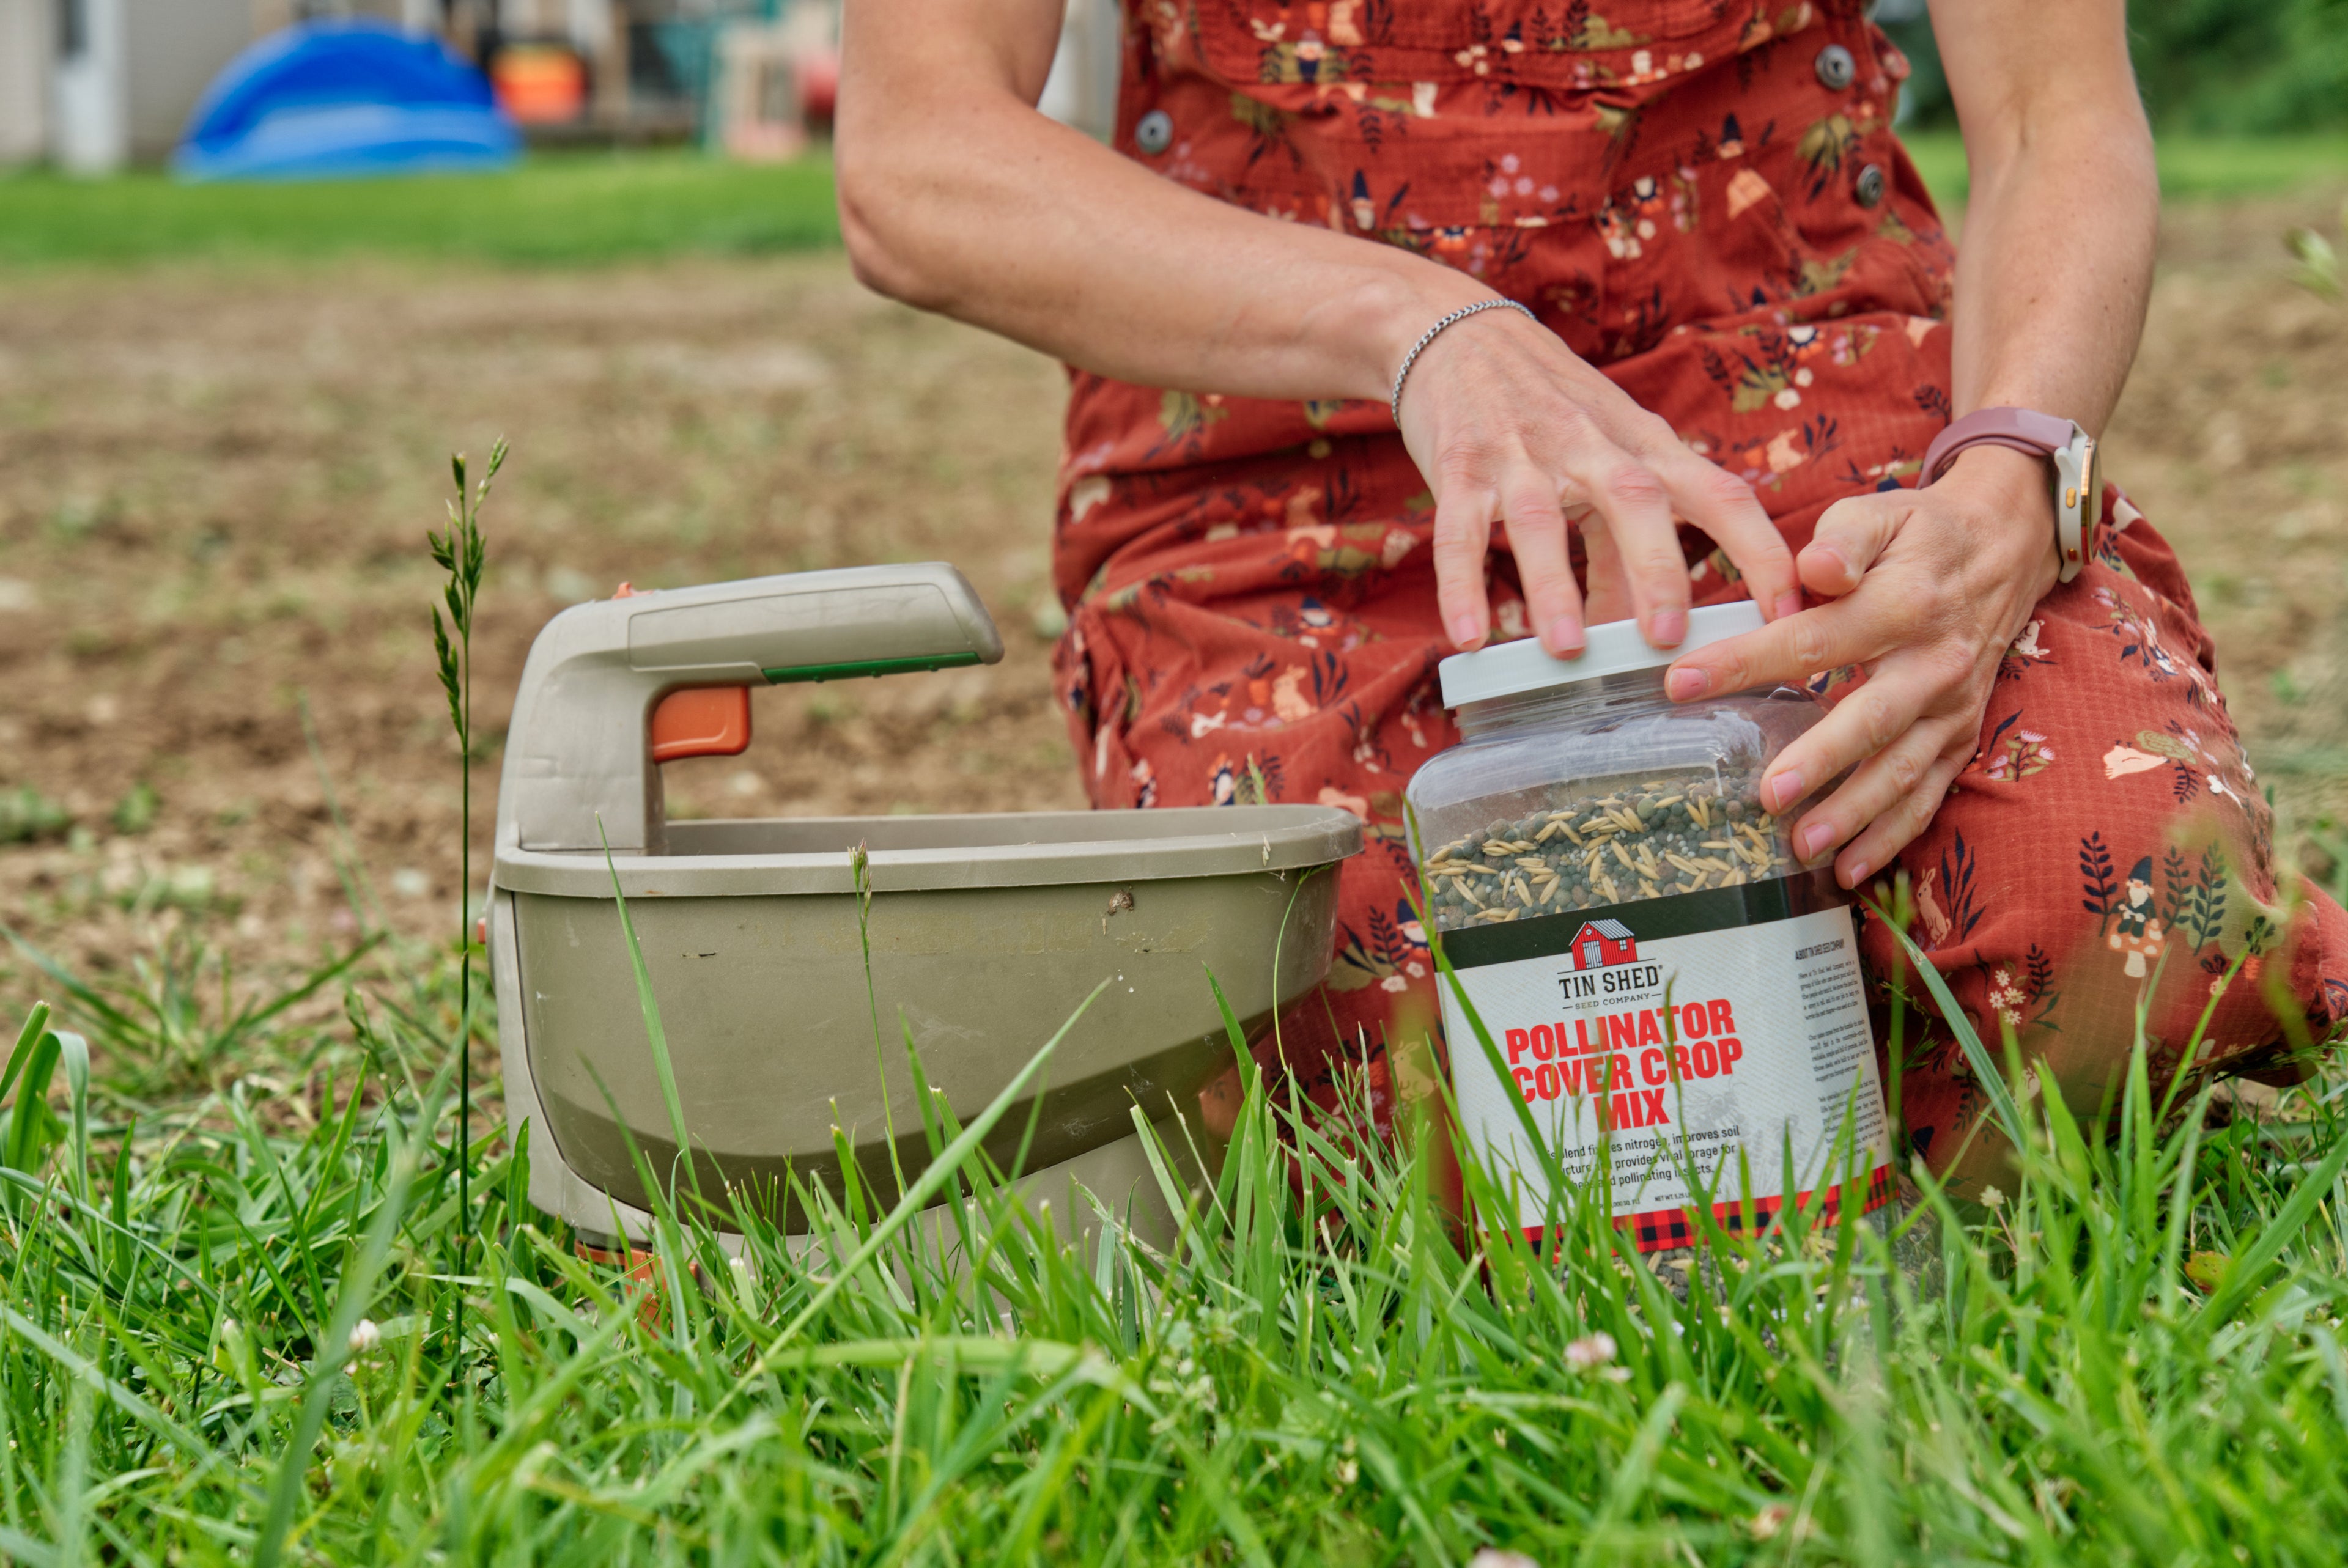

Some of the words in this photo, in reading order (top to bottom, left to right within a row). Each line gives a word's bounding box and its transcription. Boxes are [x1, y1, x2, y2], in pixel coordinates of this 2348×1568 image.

[1795, 948, 1808, 960] ABOUT
[1559, 974, 1595, 999] TIN
[1575, 1001, 1600, 1010] SEED
[1603, 993, 1651, 1006] COMPANY
[1505, 999, 1737, 1065] POLLINATOR
[1510, 1053, 1634, 1103] COVER
[1640, 1037, 1743, 1086] CROP
[1593, 1088, 1671, 1132] MIX
[1588, 1143, 1622, 1156] fies
[1625, 1136, 1671, 1150] nitrogen,
[1721, 1125, 1740, 1137] soil
[1615, 1153, 1658, 1171] provides
[1660, 1149, 1683, 1163] vial
[1691, 1147, 1718, 1159] orage
[1721, 1144, 1735, 1154] for
[1598, 1175, 1616, 1188] ad
[1619, 1168, 1671, 1187] pollinating
[1674, 1165, 1715, 1177] iscts.
